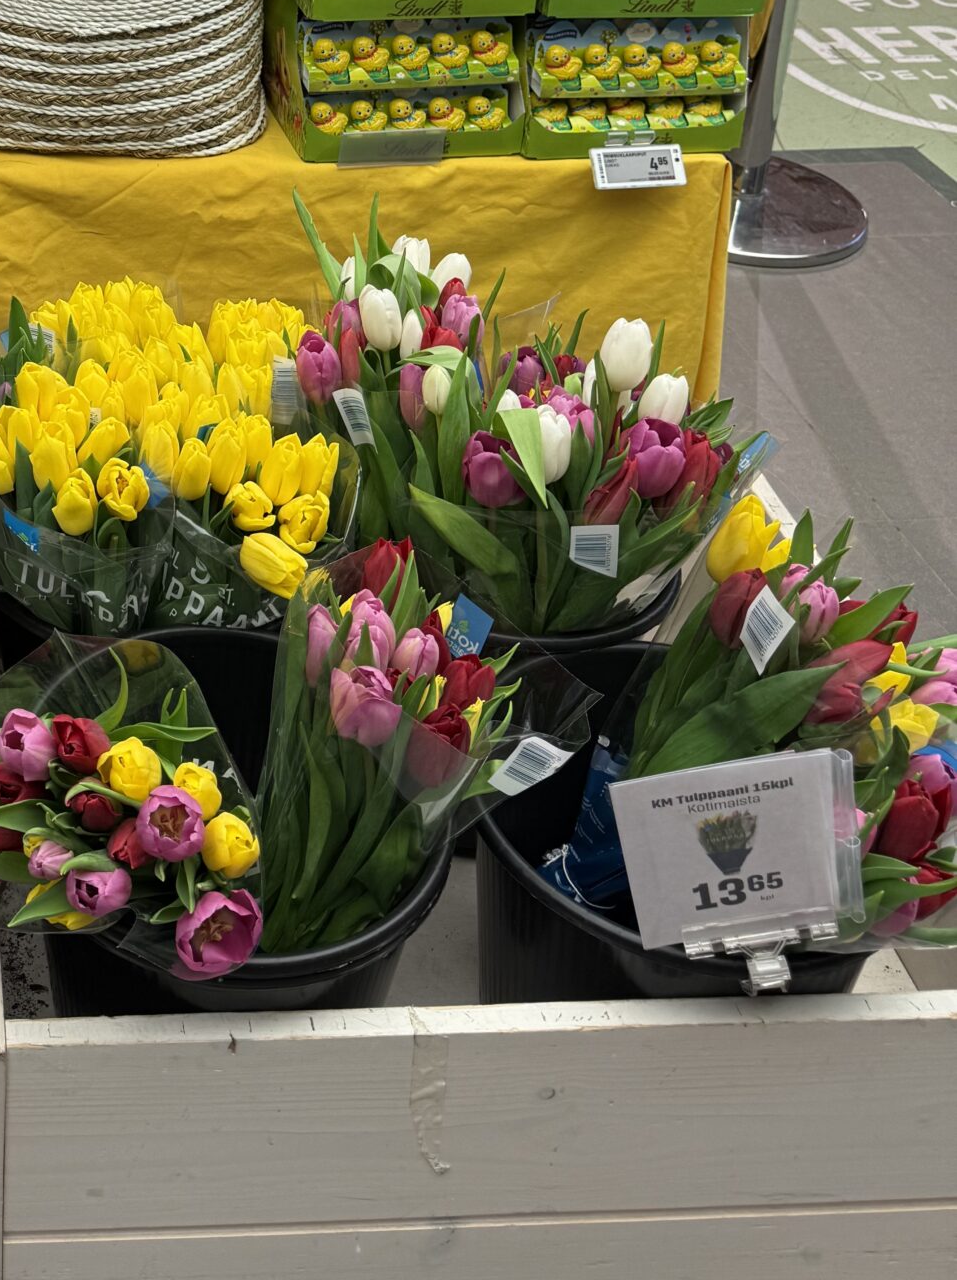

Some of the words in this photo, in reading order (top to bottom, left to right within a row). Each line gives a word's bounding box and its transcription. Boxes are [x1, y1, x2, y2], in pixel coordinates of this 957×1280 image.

[387, 0, 448, 17] Lindt
[793, 25, 957, 65] HER
[380, 140, 441, 157] Lindt
[652, 797, 673, 809] KM
[676, 786, 749, 804] Tulppaani
[753, 776, 794, 793] 15kpl
[687, 795, 761, 814] Kotimaista
